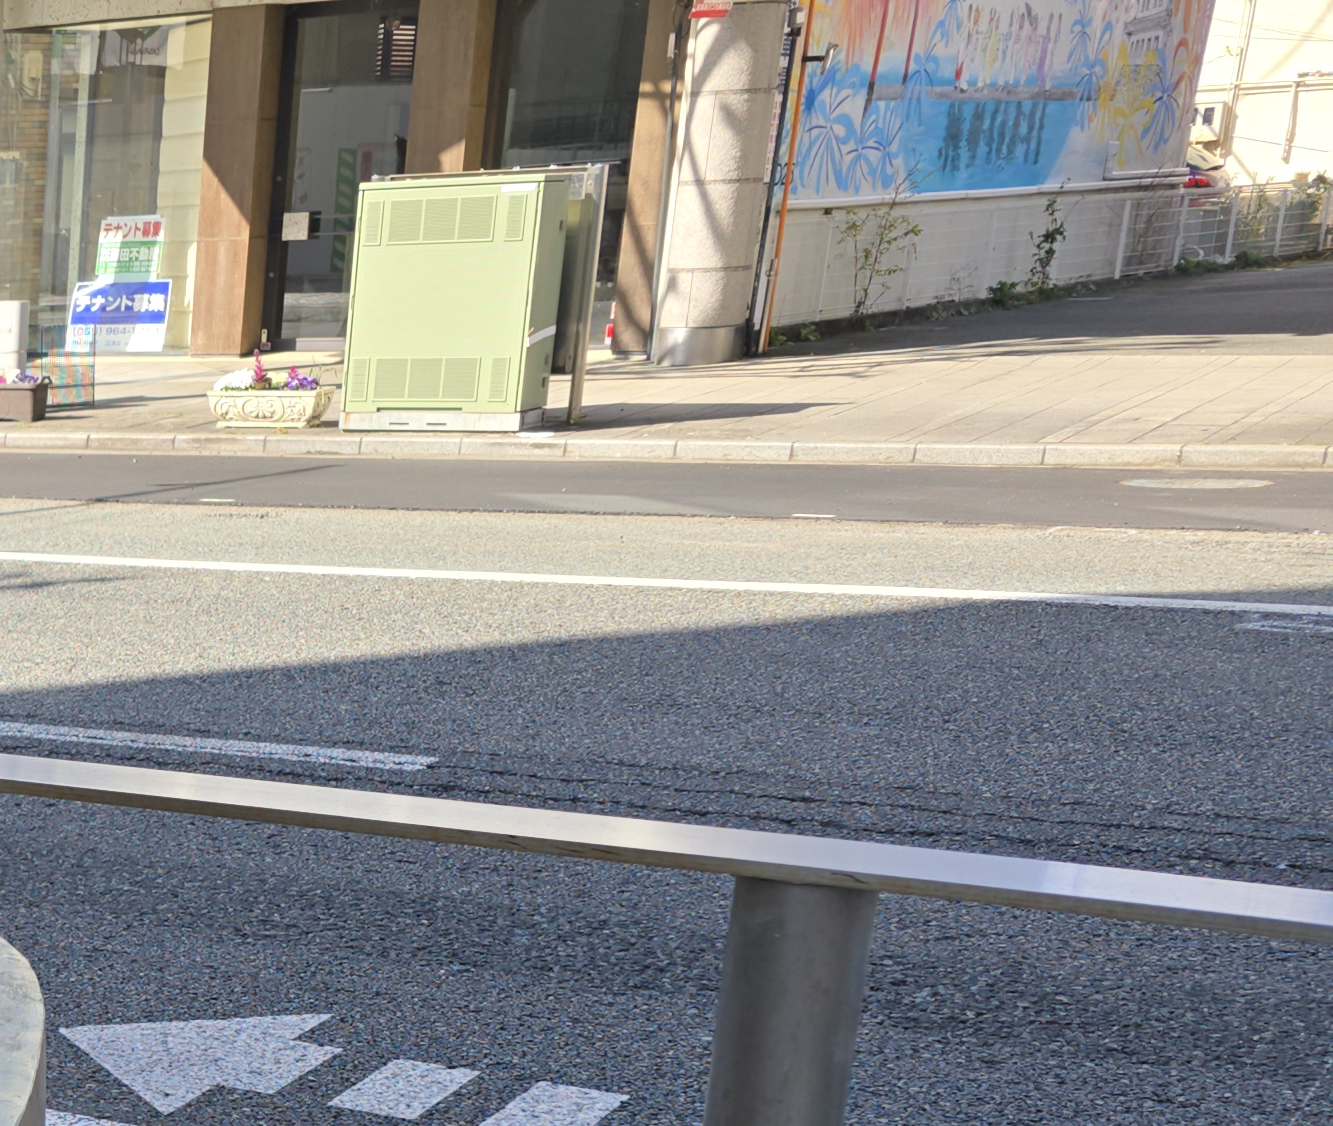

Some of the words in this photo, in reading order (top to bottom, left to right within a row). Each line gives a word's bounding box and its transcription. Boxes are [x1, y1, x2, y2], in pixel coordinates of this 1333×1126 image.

[103, 220, 163, 239] テナント募集
[75, 293, 166, 312] テナント募集
